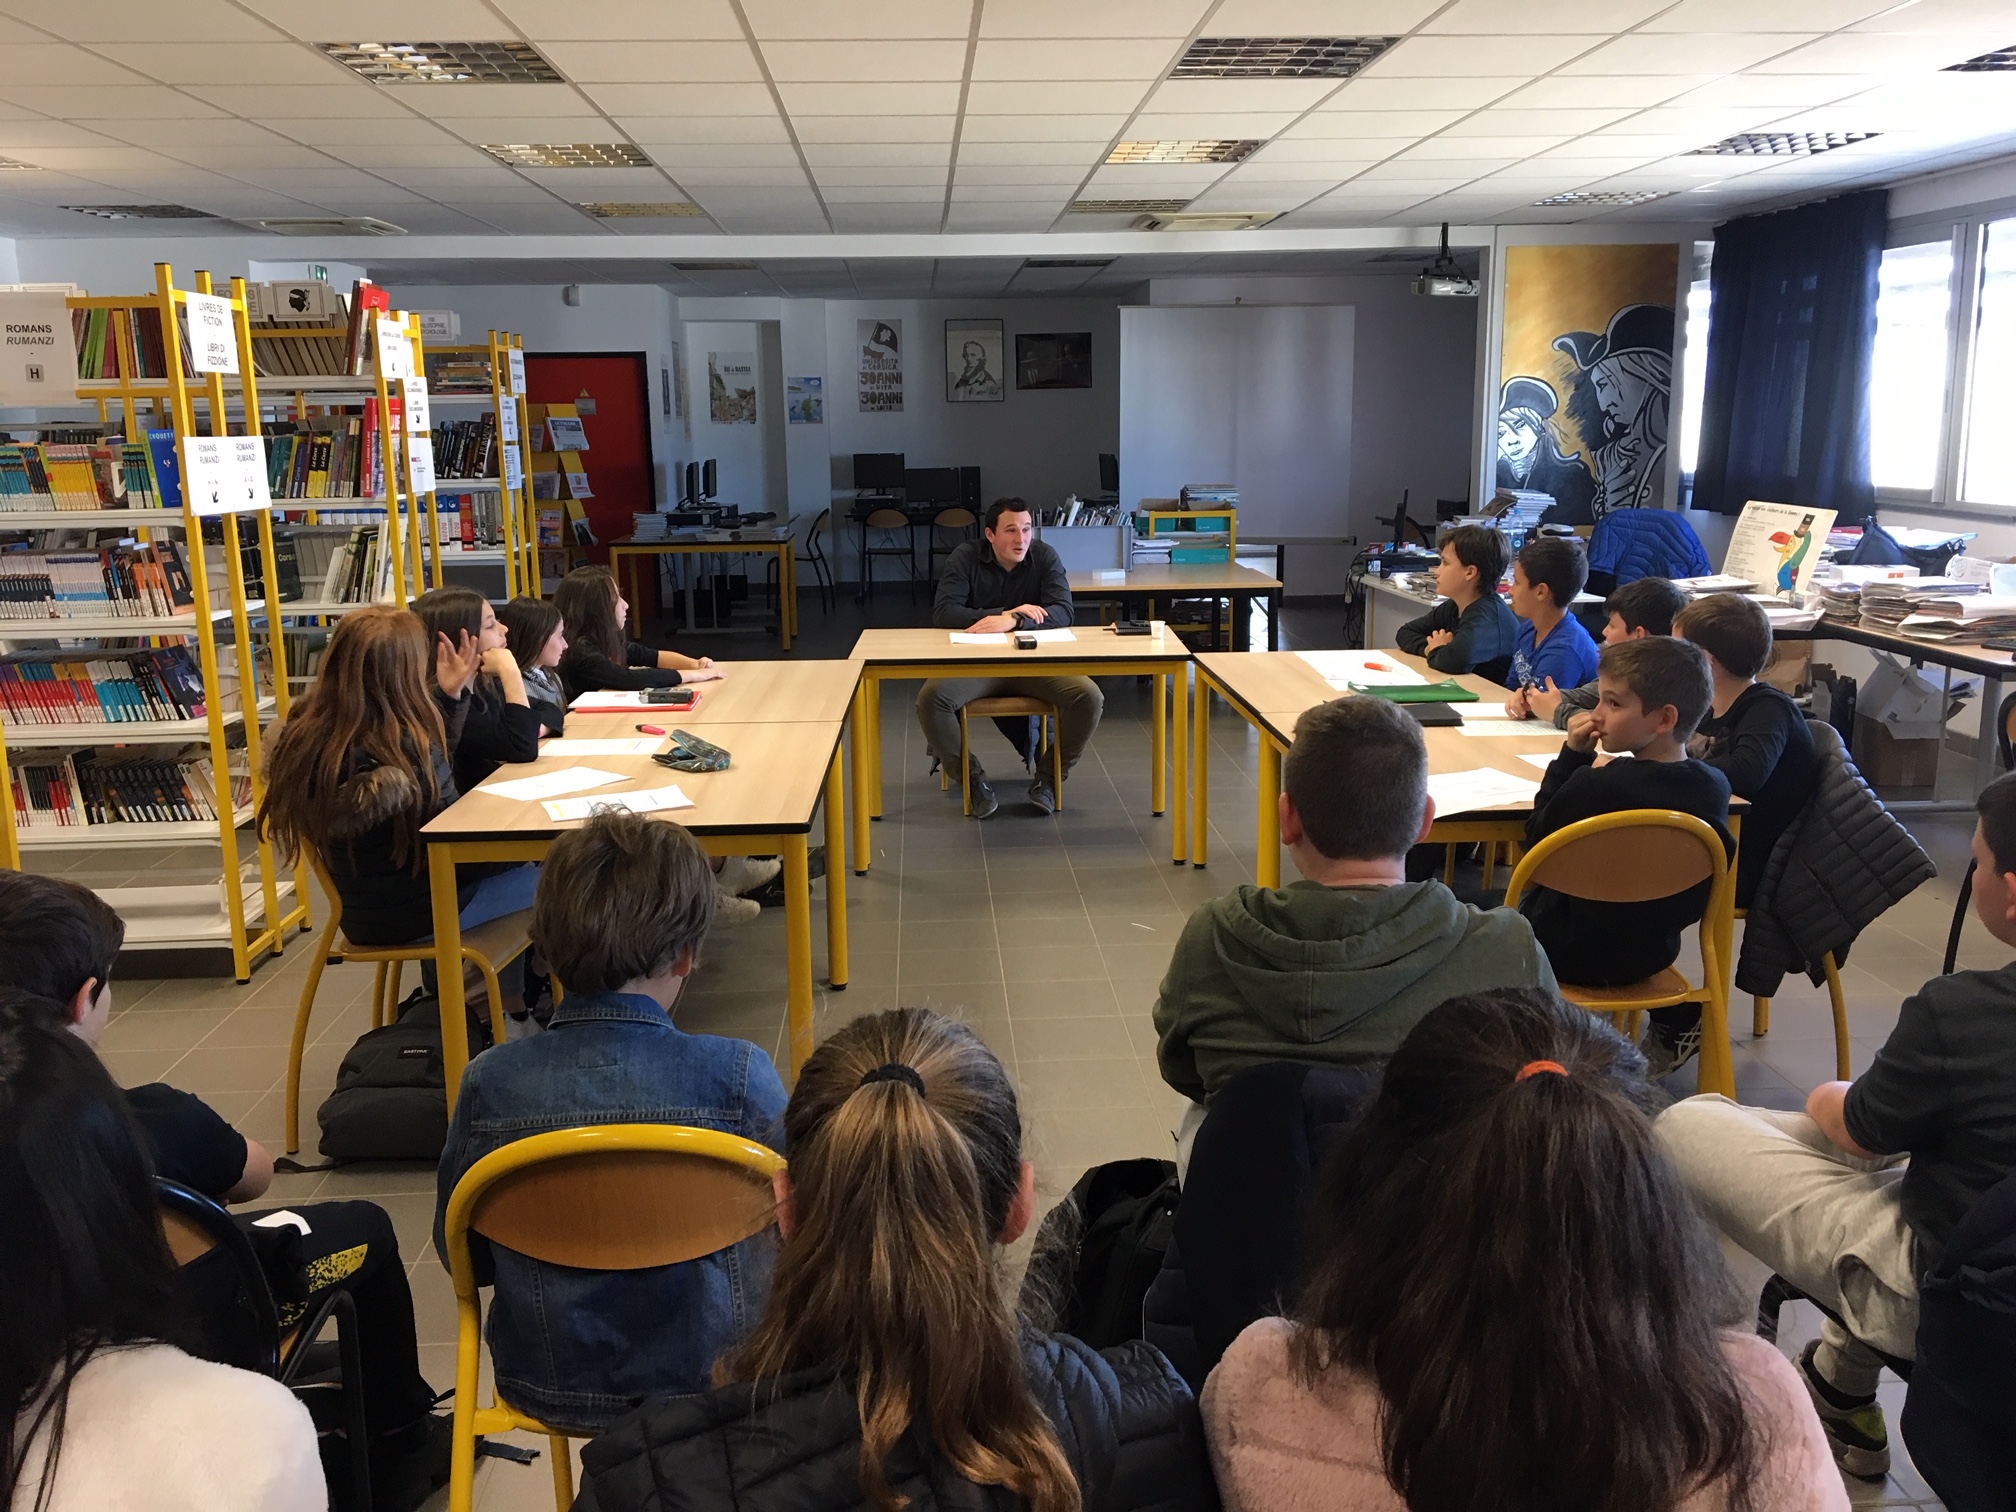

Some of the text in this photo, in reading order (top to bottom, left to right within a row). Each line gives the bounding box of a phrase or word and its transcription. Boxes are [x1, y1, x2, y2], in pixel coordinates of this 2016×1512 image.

[198, 302, 223, 314] LIVRES DE
[203, 315, 223, 326] FICTION
[6, 324, 52, 333] ROMANS
[6, 336, 54, 345] RUMANZI
[207, 343, 219, 352] LIBRI
[207, 355, 228, 366] FIZZIONE
[30, 368, 39, 379] H
[148, 432, 174, 440] CHOUETT
[198, 444, 217, 452] ROMANS
[236, 443, 254, 451] ROMANS
[237, 454, 256, 462] RUMANZI
